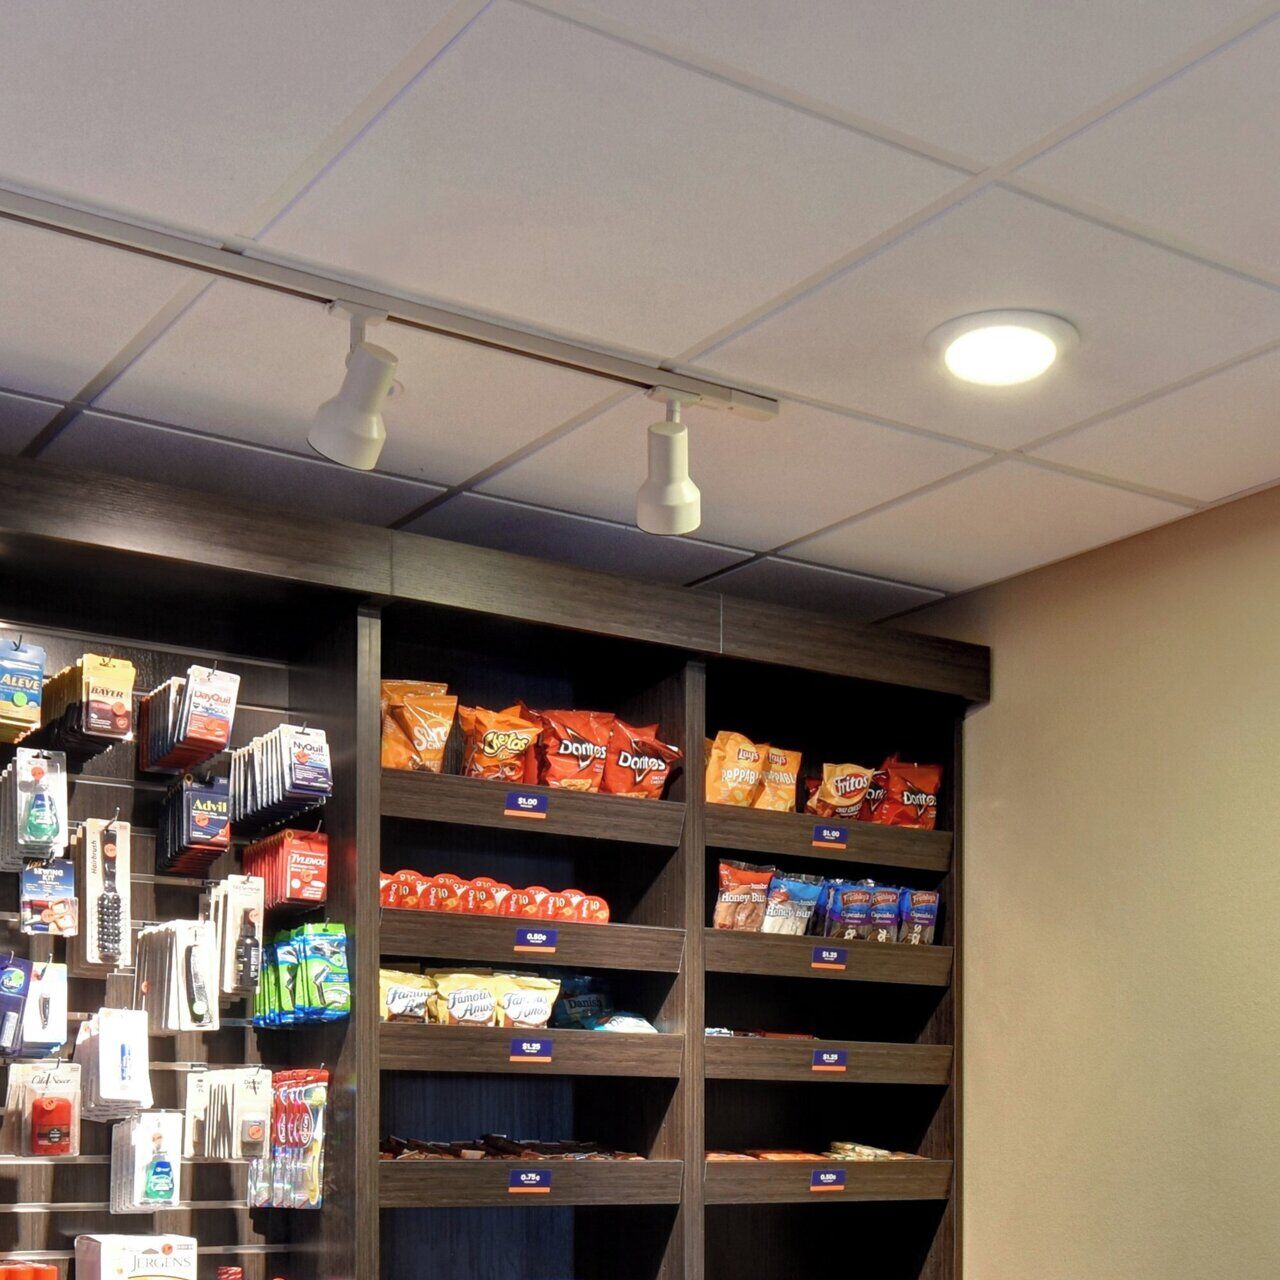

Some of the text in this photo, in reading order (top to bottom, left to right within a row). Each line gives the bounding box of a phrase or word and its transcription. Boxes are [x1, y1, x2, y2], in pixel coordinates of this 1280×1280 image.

[0, 673, 41, 691] ALEVE
[90, 686, 124, 699] BAYER
[293, 741, 324, 753] NyQuil
[484, 731, 531, 754] Cheetos
[559, 740, 607, 760] Doritos
[618, 751, 666, 771] Doritos
[834, 775, 869, 796] Fritos
[193, 799, 227, 813] Advil
[517, 797, 538, 806] $1.00
[291, 853, 326, 867] TYLENOL
[721, 891, 750, 904] Honey
[767, 904, 794, 919] Honey
[447, 987, 493, 1010] Famous
[461, 1002, 495, 1019] Amos
[131, 1254, 192, 1272] JERGENS
